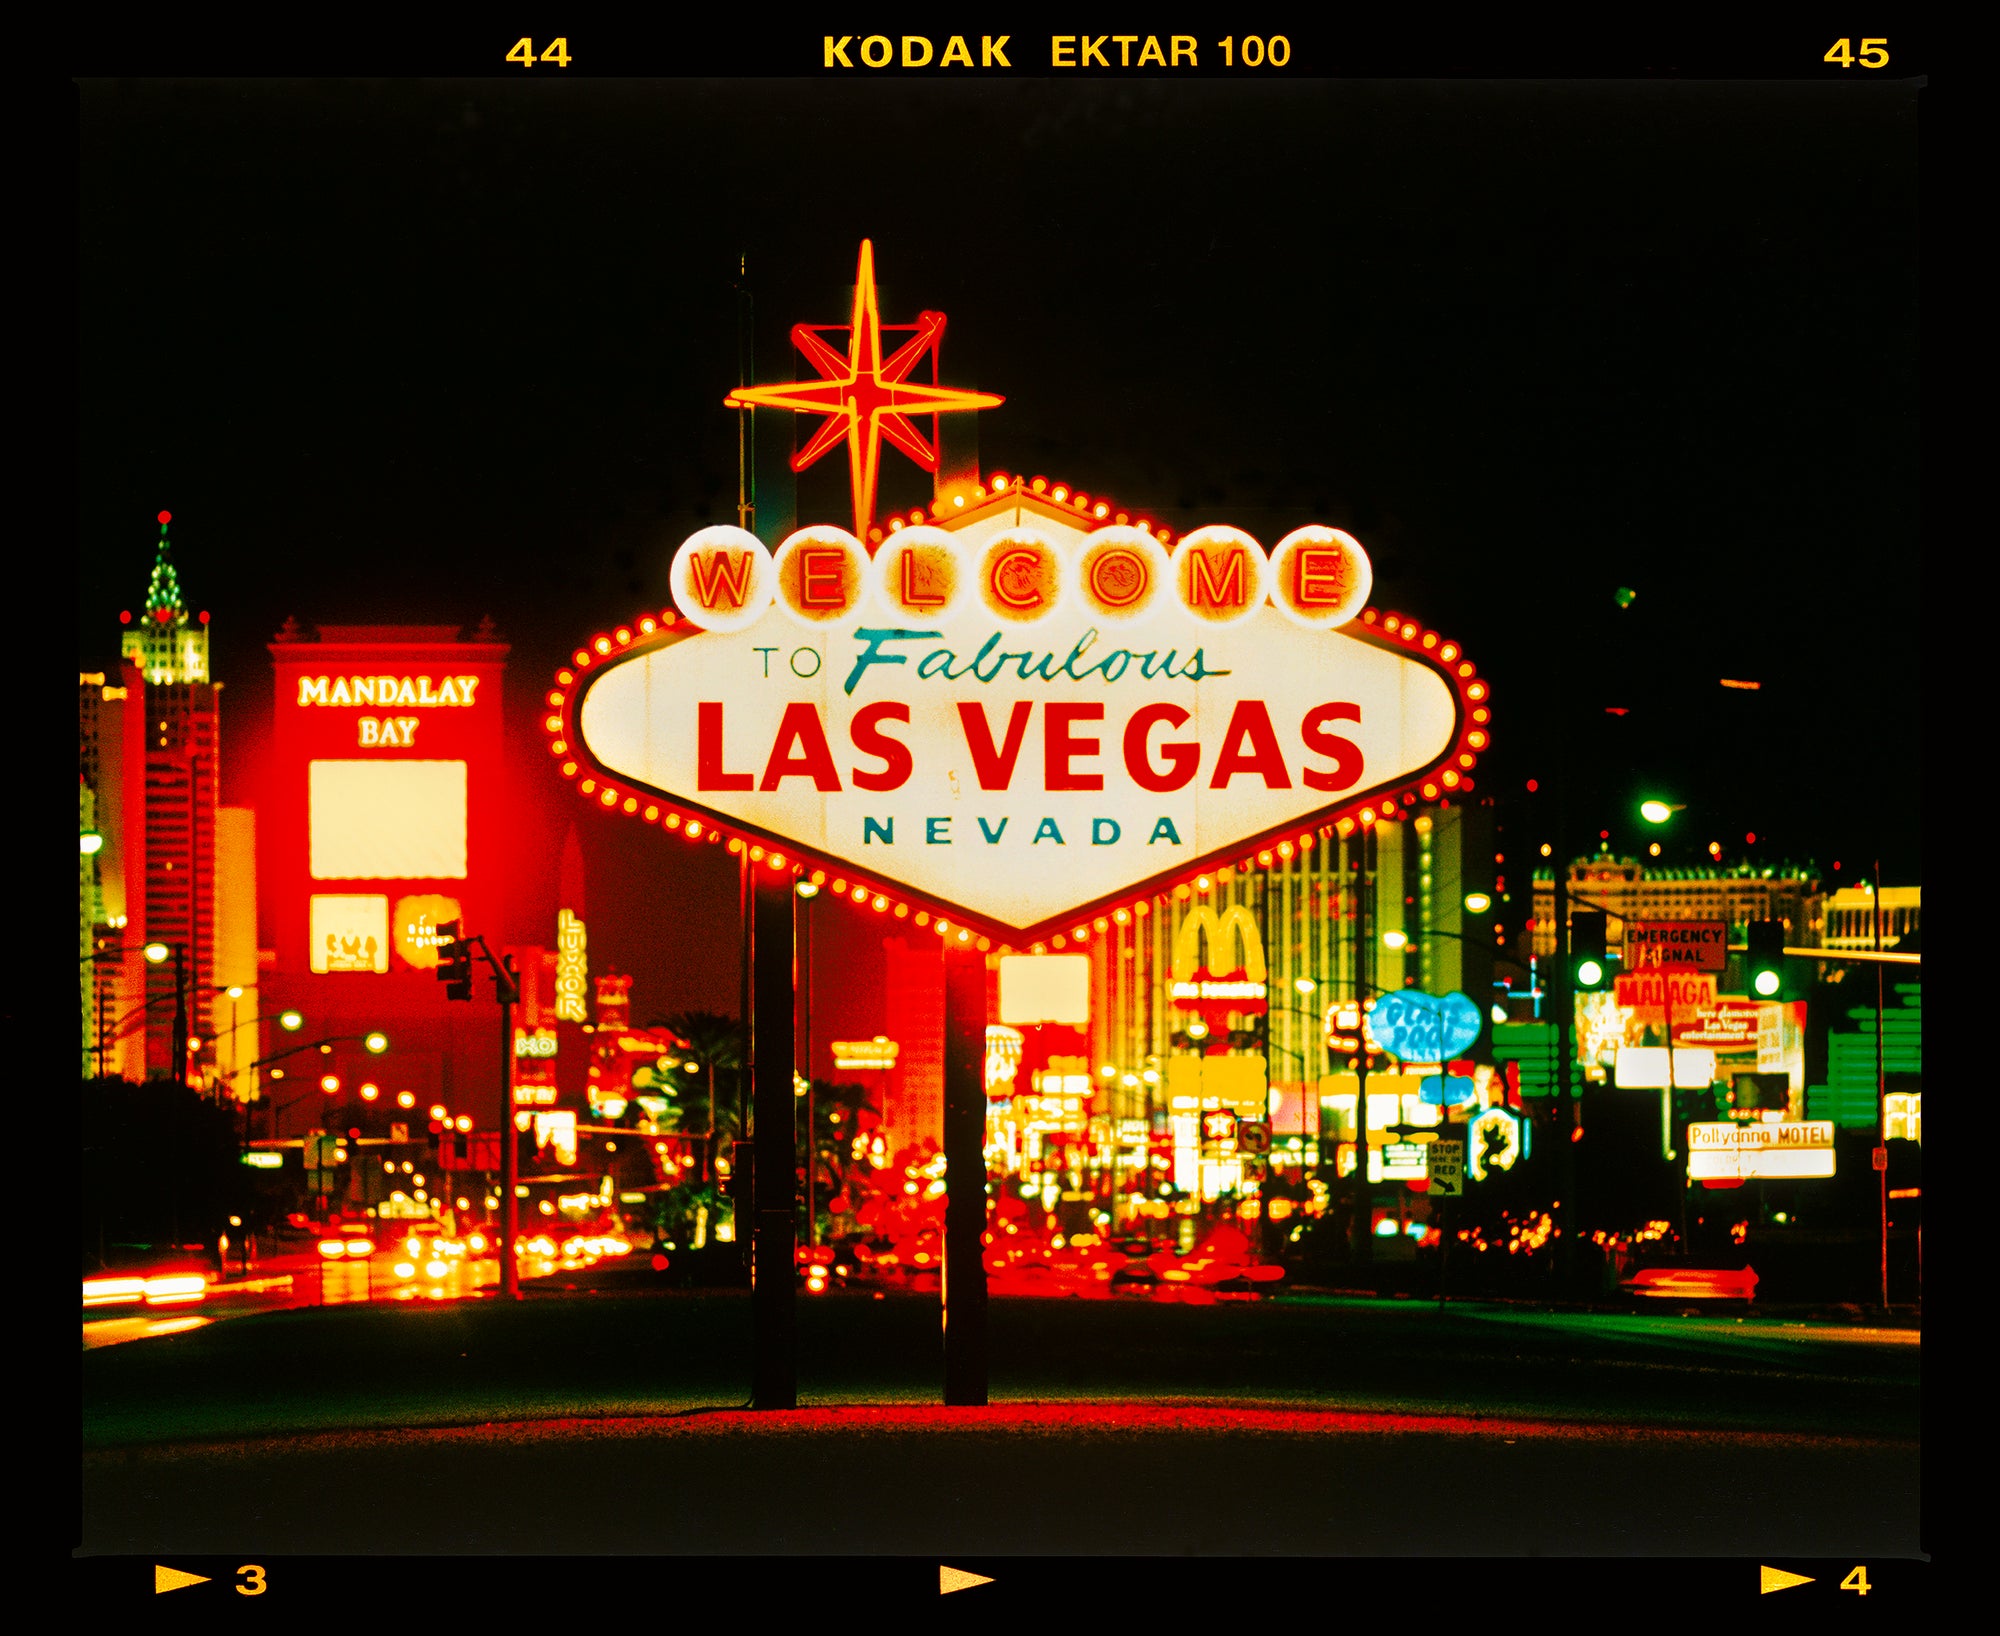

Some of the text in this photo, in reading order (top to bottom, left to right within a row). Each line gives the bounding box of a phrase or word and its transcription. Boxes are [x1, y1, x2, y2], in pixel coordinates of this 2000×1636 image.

[505, 37, 573, 68] 44
[823, 34, 1291, 68] KODAK EKTAR 100
[1823, 37, 1890, 69] 45
[684, 544, 1346, 613] WELCOME
[753, 627, 1230, 696] TO Fabulous
[299, 676, 479, 706] MANDALAY
[359, 718, 418, 746] BAY
[697, 700, 1365, 792] LAS VEGAS
[863, 816, 1182, 846] NEVADA
[1627, 929, 1723, 944] EMERGENCY
[1617, 979, 1712, 1007] MALAGA
[1432, 1144, 1460, 1154] STOP
[1692, 1126, 1830, 1145] Pollyanna MOTEL
[1434, 1165, 1456, 1175] RED
[235, 1564, 267, 1596] 3
[1839, 1565, 1872, 1596] 4
